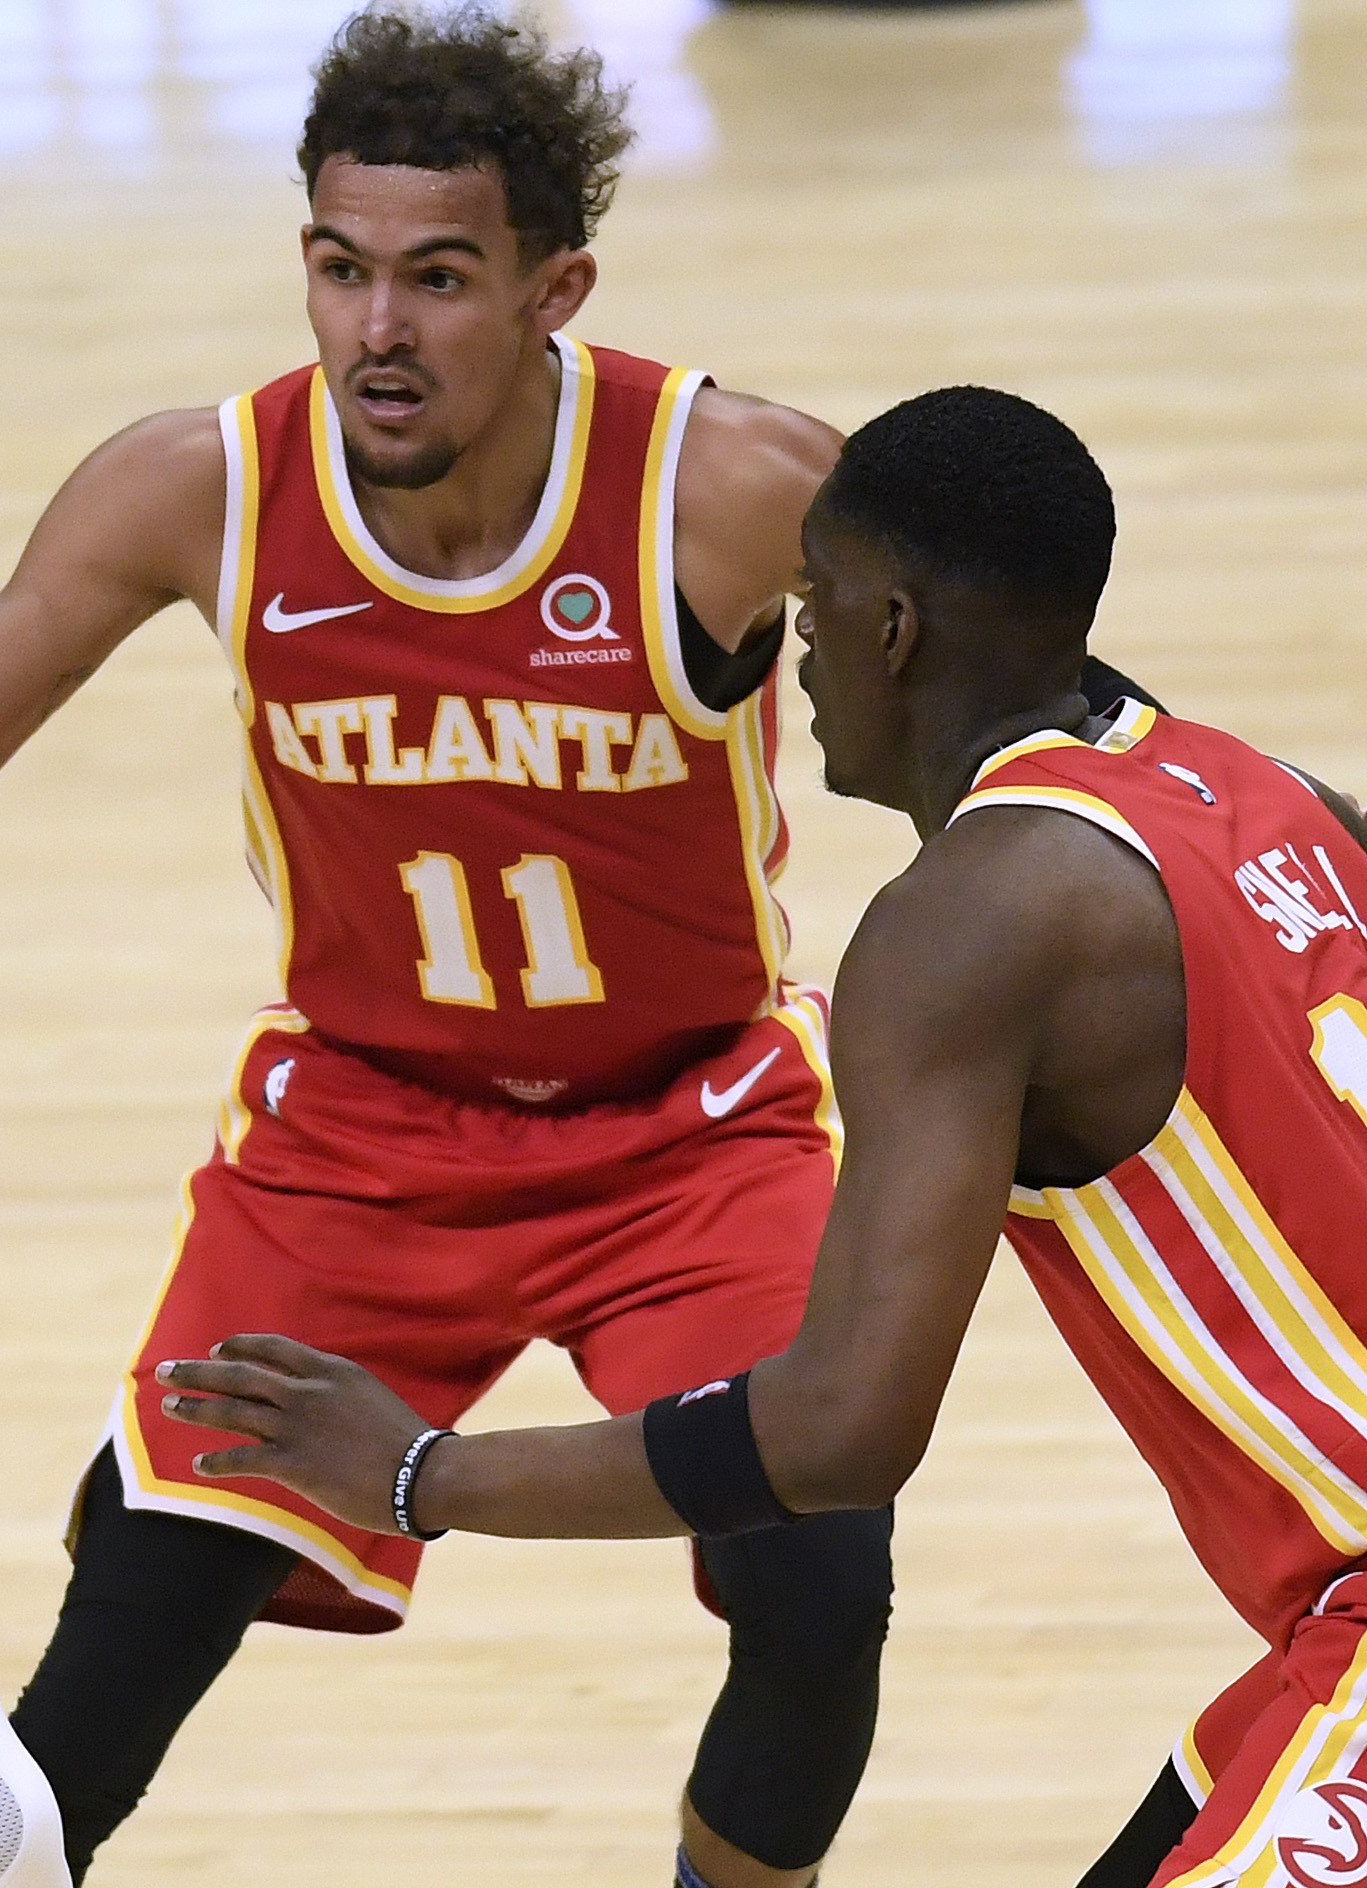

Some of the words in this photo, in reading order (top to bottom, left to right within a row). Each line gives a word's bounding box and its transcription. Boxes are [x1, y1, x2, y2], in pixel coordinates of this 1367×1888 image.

[529, 647, 632, 667] sharecare
[264, 694, 689, 792] ATLANTA
[398, 850, 606, 1010] 11
[394, 1468, 412, 1506] Give
